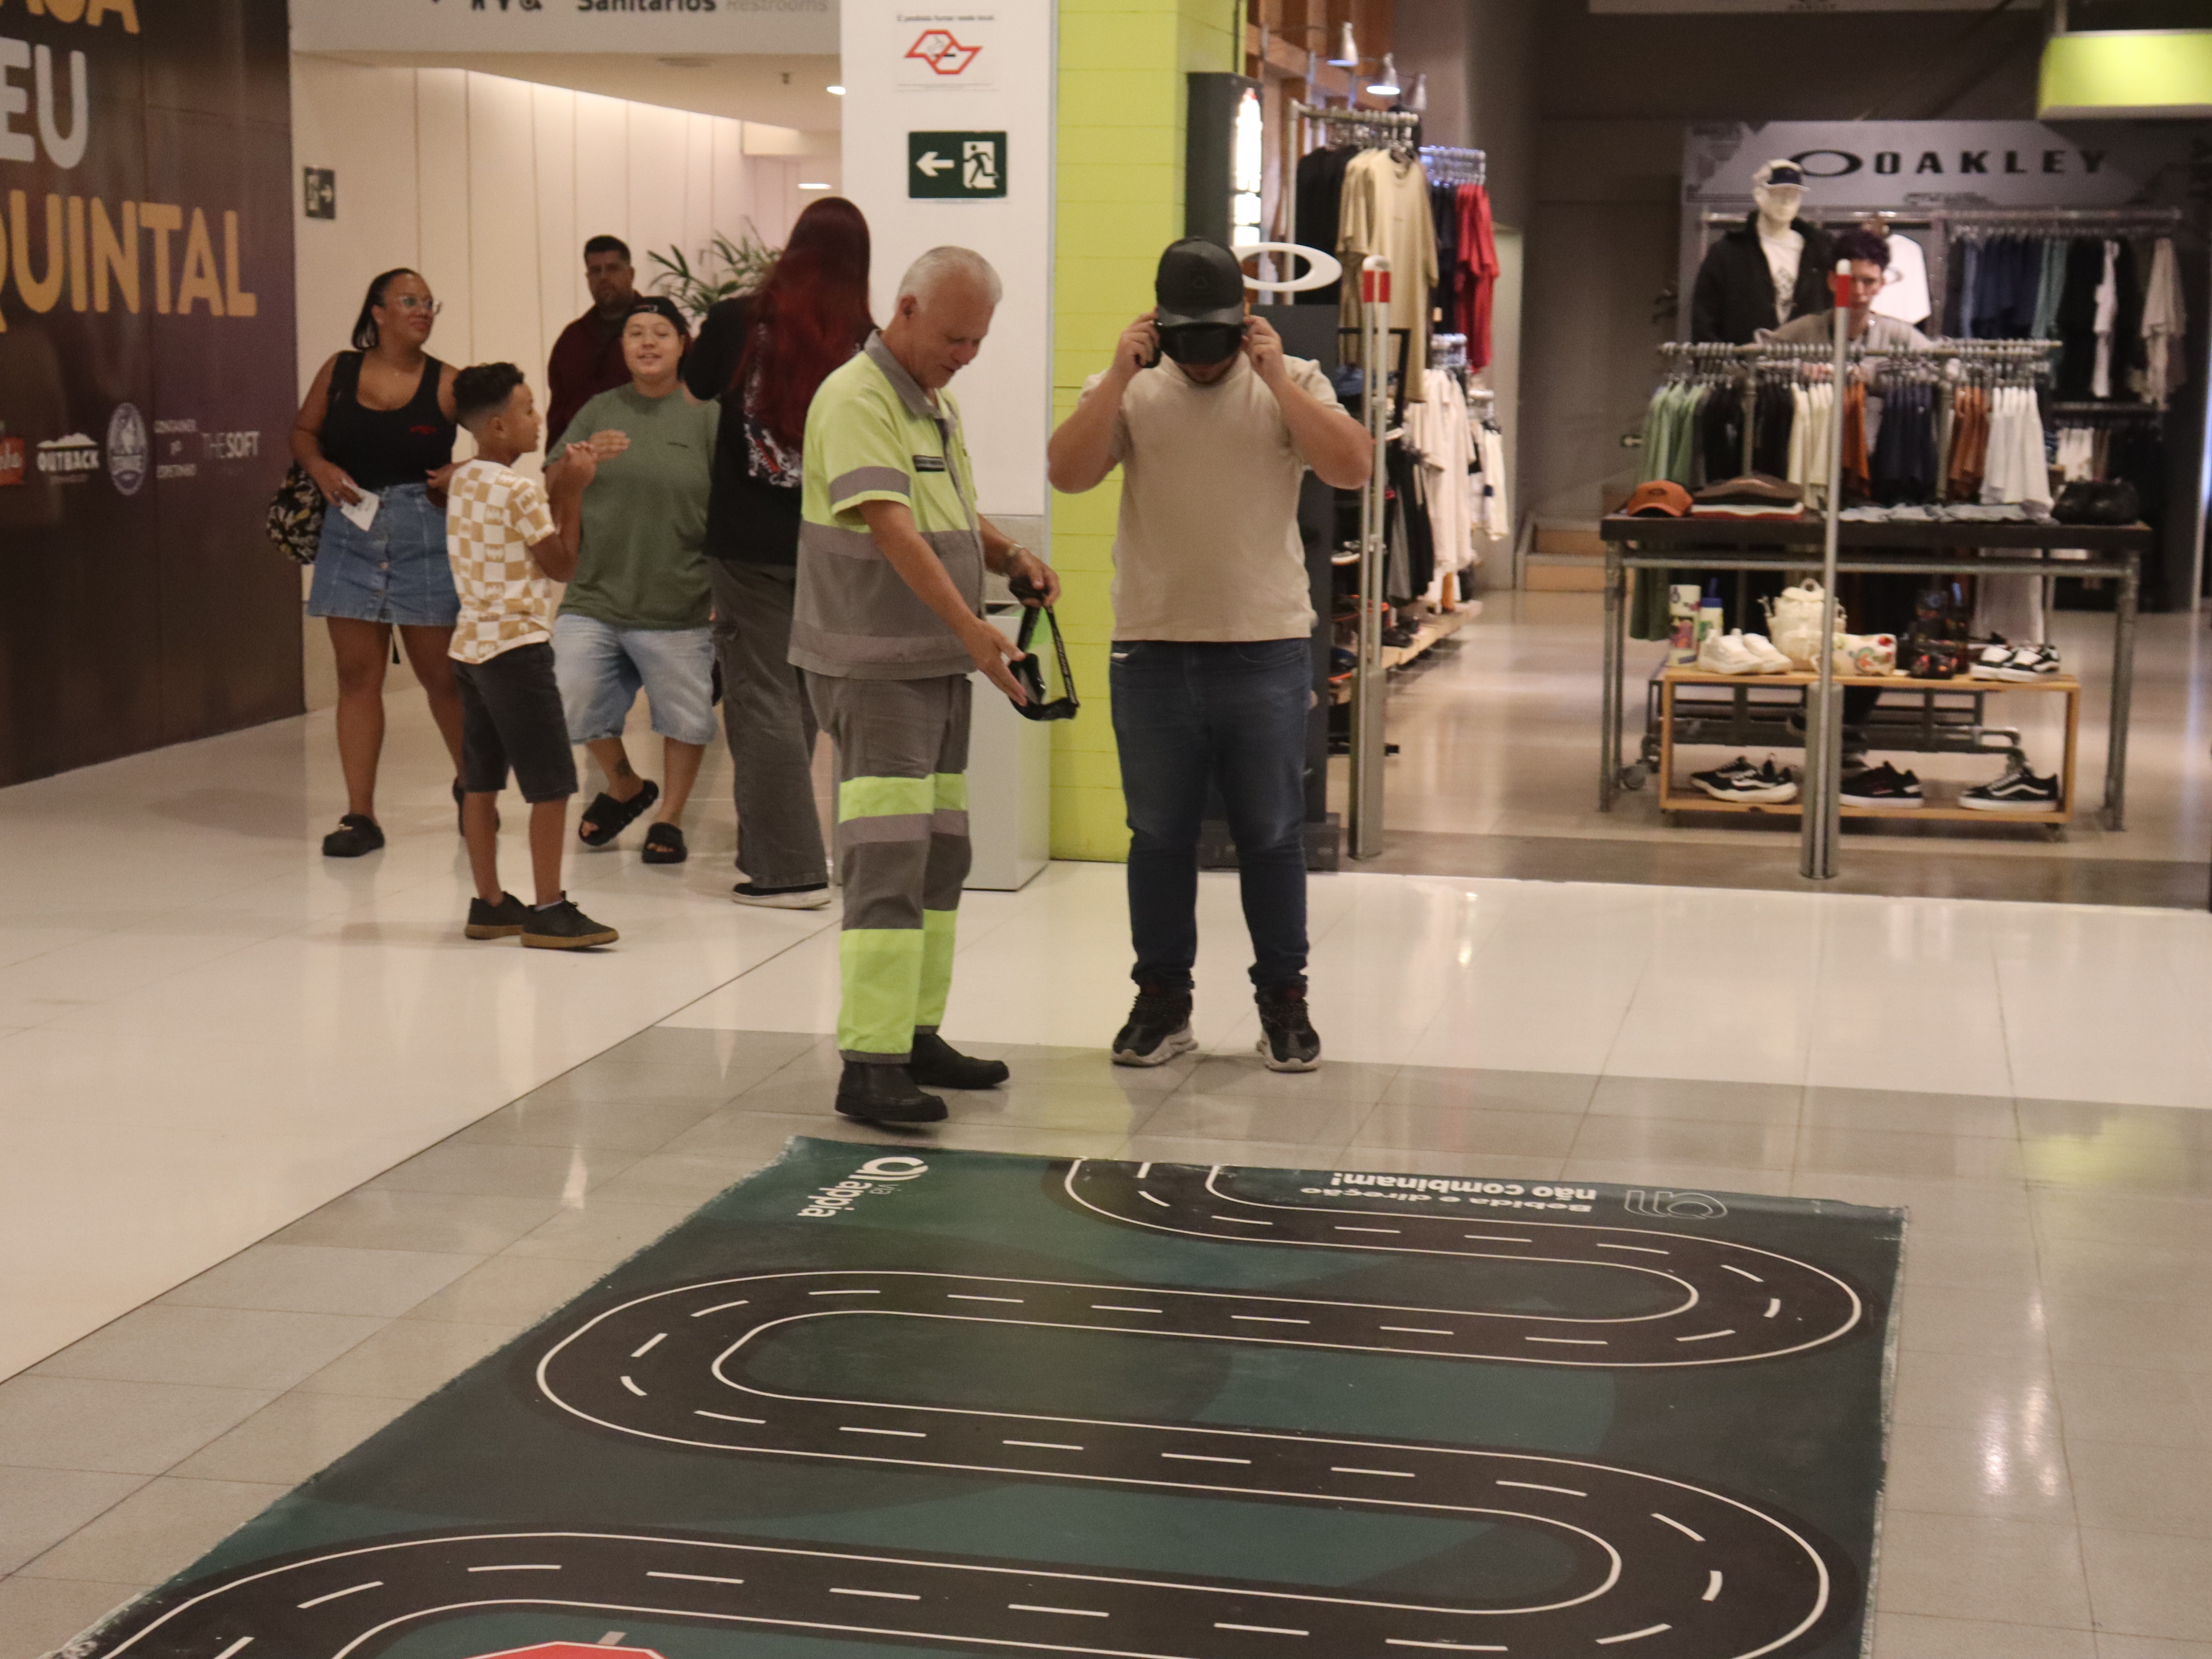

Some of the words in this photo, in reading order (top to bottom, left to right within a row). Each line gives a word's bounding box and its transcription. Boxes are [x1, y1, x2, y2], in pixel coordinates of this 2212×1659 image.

[1874, 150, 2107, 175] OAKLEY
[0, 190, 257, 328] UINTAL
[37, 450, 100, 472] OUTBACK
[1300, 1187, 1432, 1202] direção
[1330, 1172, 1525, 1196] combinam!
[1532, 1186, 1597, 1201] não
[796, 1180, 873, 1217] appia
[1469, 1197, 1592, 1212] Bebida
